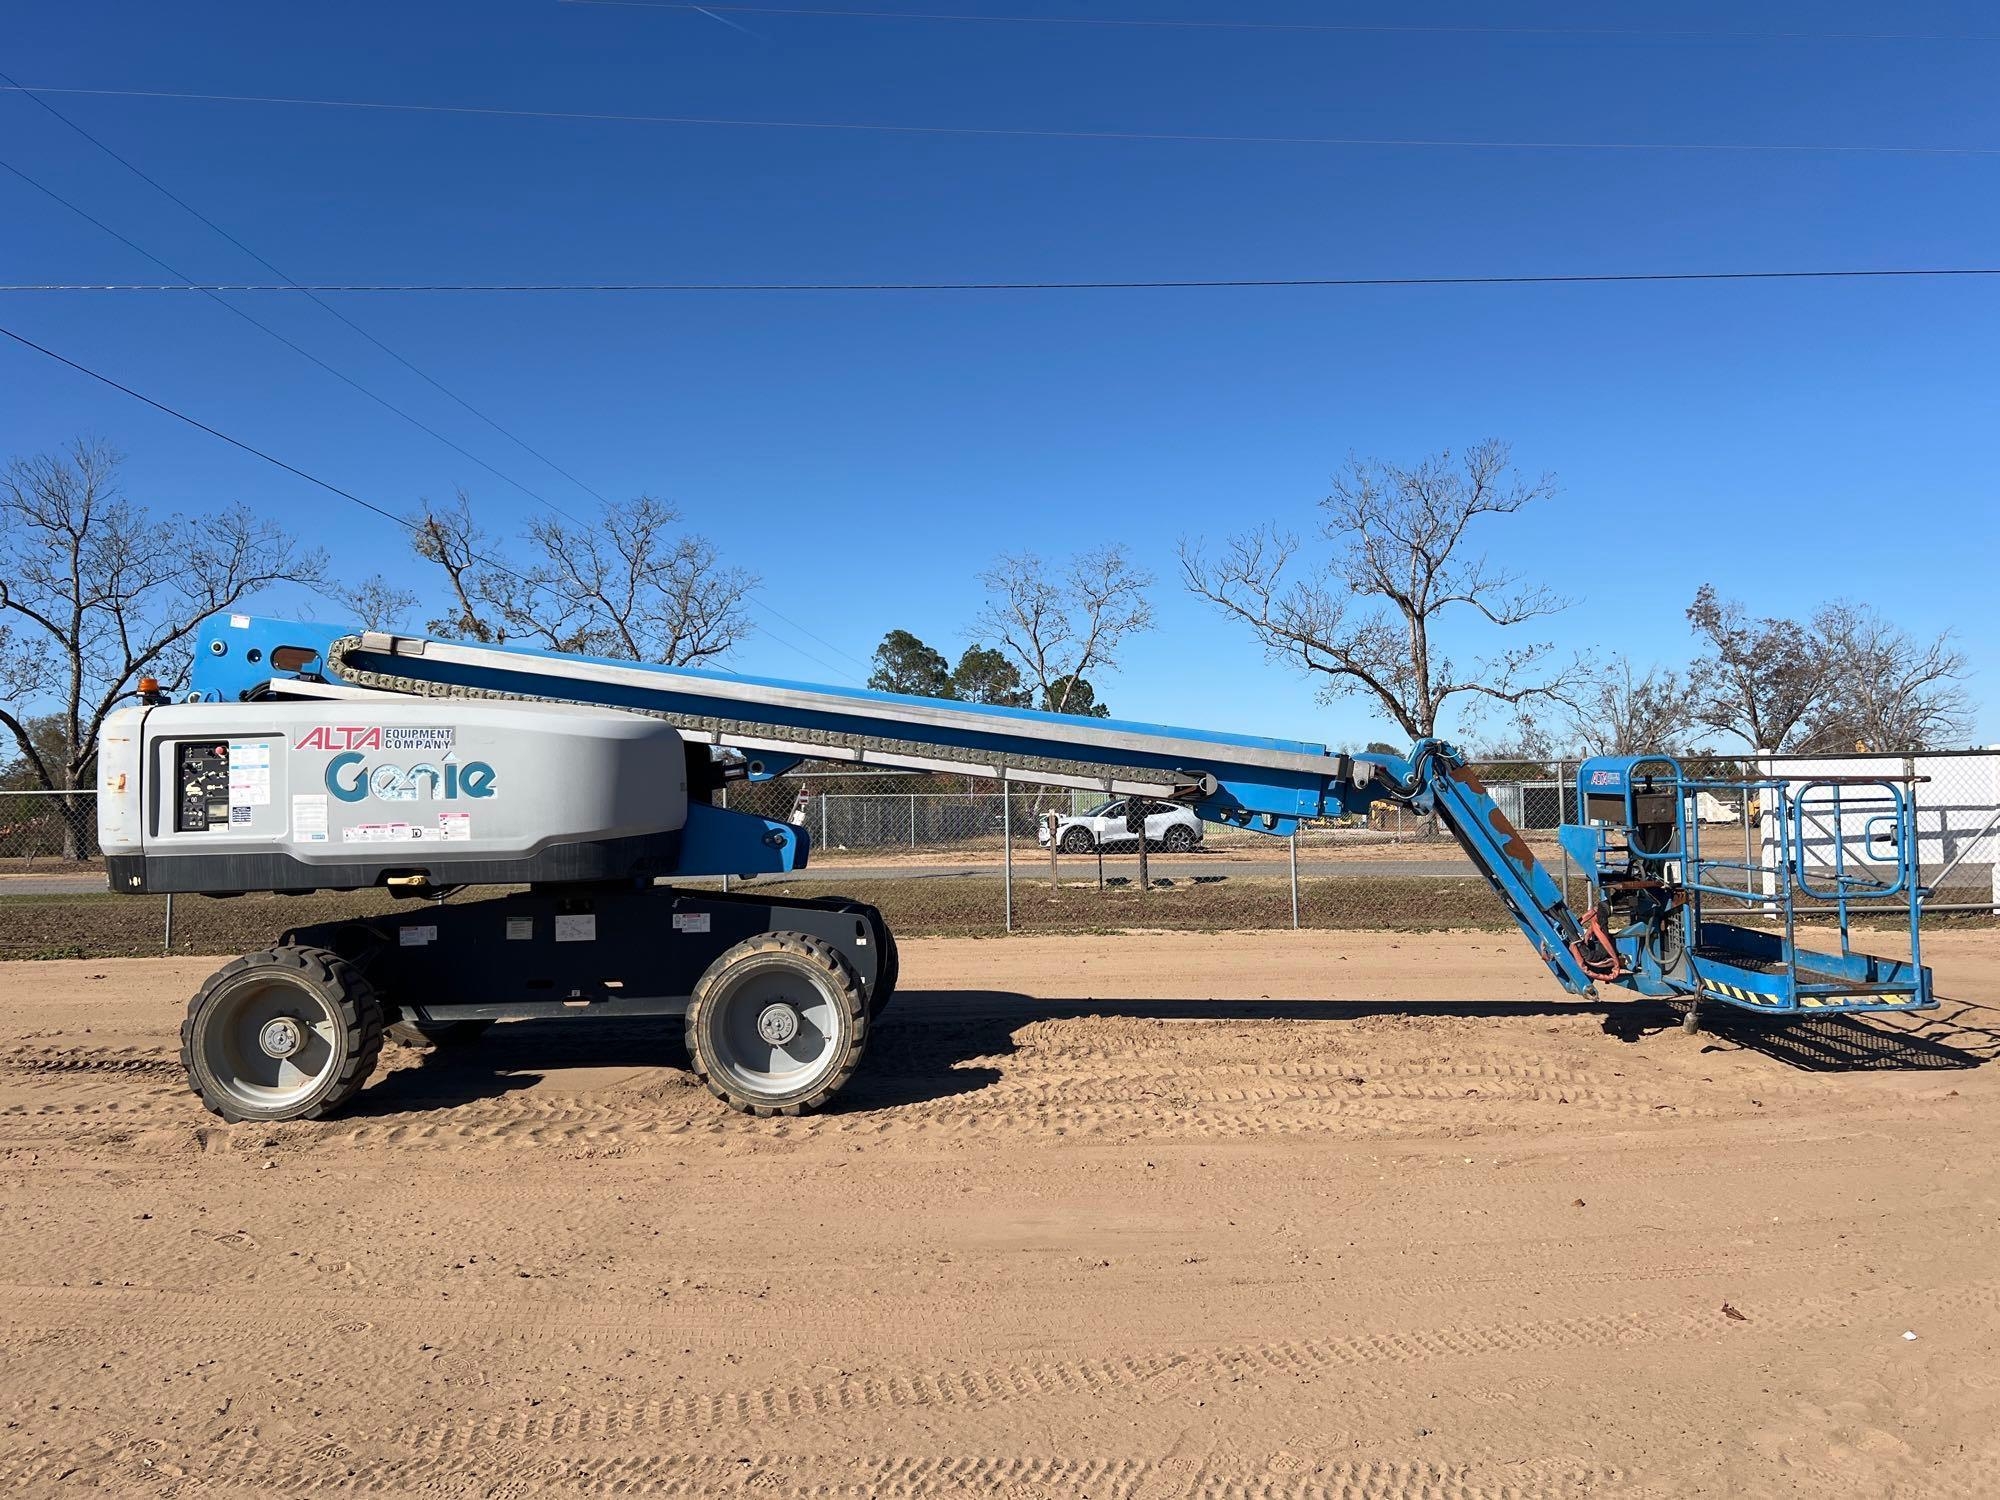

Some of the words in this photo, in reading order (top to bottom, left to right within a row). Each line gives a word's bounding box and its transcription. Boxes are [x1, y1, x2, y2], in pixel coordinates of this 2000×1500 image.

[295, 727, 381, 750] ALTA
[385, 729, 451, 739] EQUIPMENT
[385, 739, 450, 749] COMPANY
[325, 751, 498, 802] Genie
